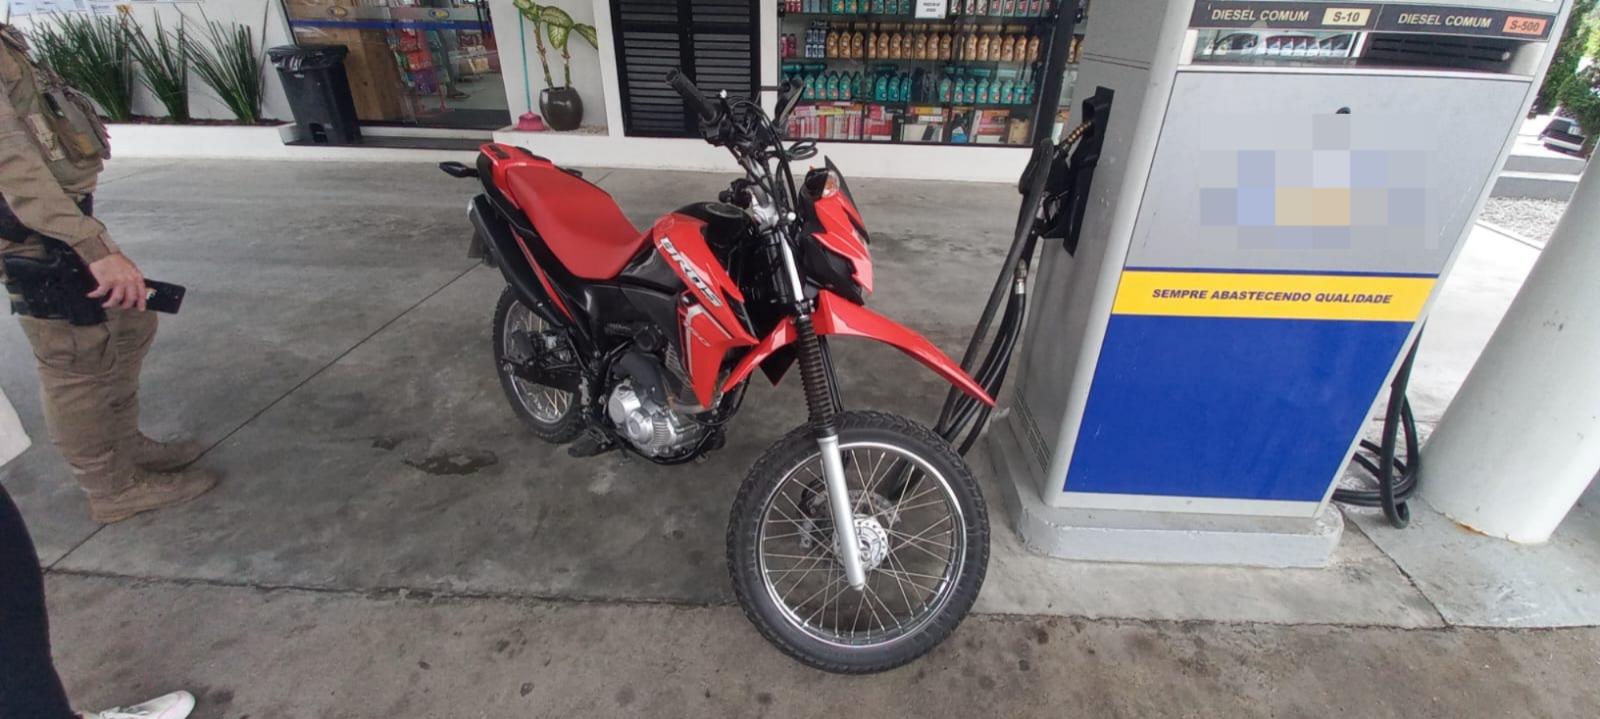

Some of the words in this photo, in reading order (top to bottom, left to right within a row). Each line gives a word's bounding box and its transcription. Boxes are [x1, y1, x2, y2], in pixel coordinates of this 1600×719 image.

[1212, 9, 1256, 21] DIESEL
[1260, 10, 1309, 22] COMUM
[1332, 11, 1361, 22] S-10
[1398, 13, 1442, 26] DIESEL
[1446, 15, 1492, 28] COMUM
[1510, 20, 1540, 32] S-500
[660, 237, 723, 308] BROS
[1152, 288, 1208, 300] SEMPRE
[1210, 290, 1312, 303] ABASTECENDO
[1315, 292, 1393, 304] QUALIDADE
